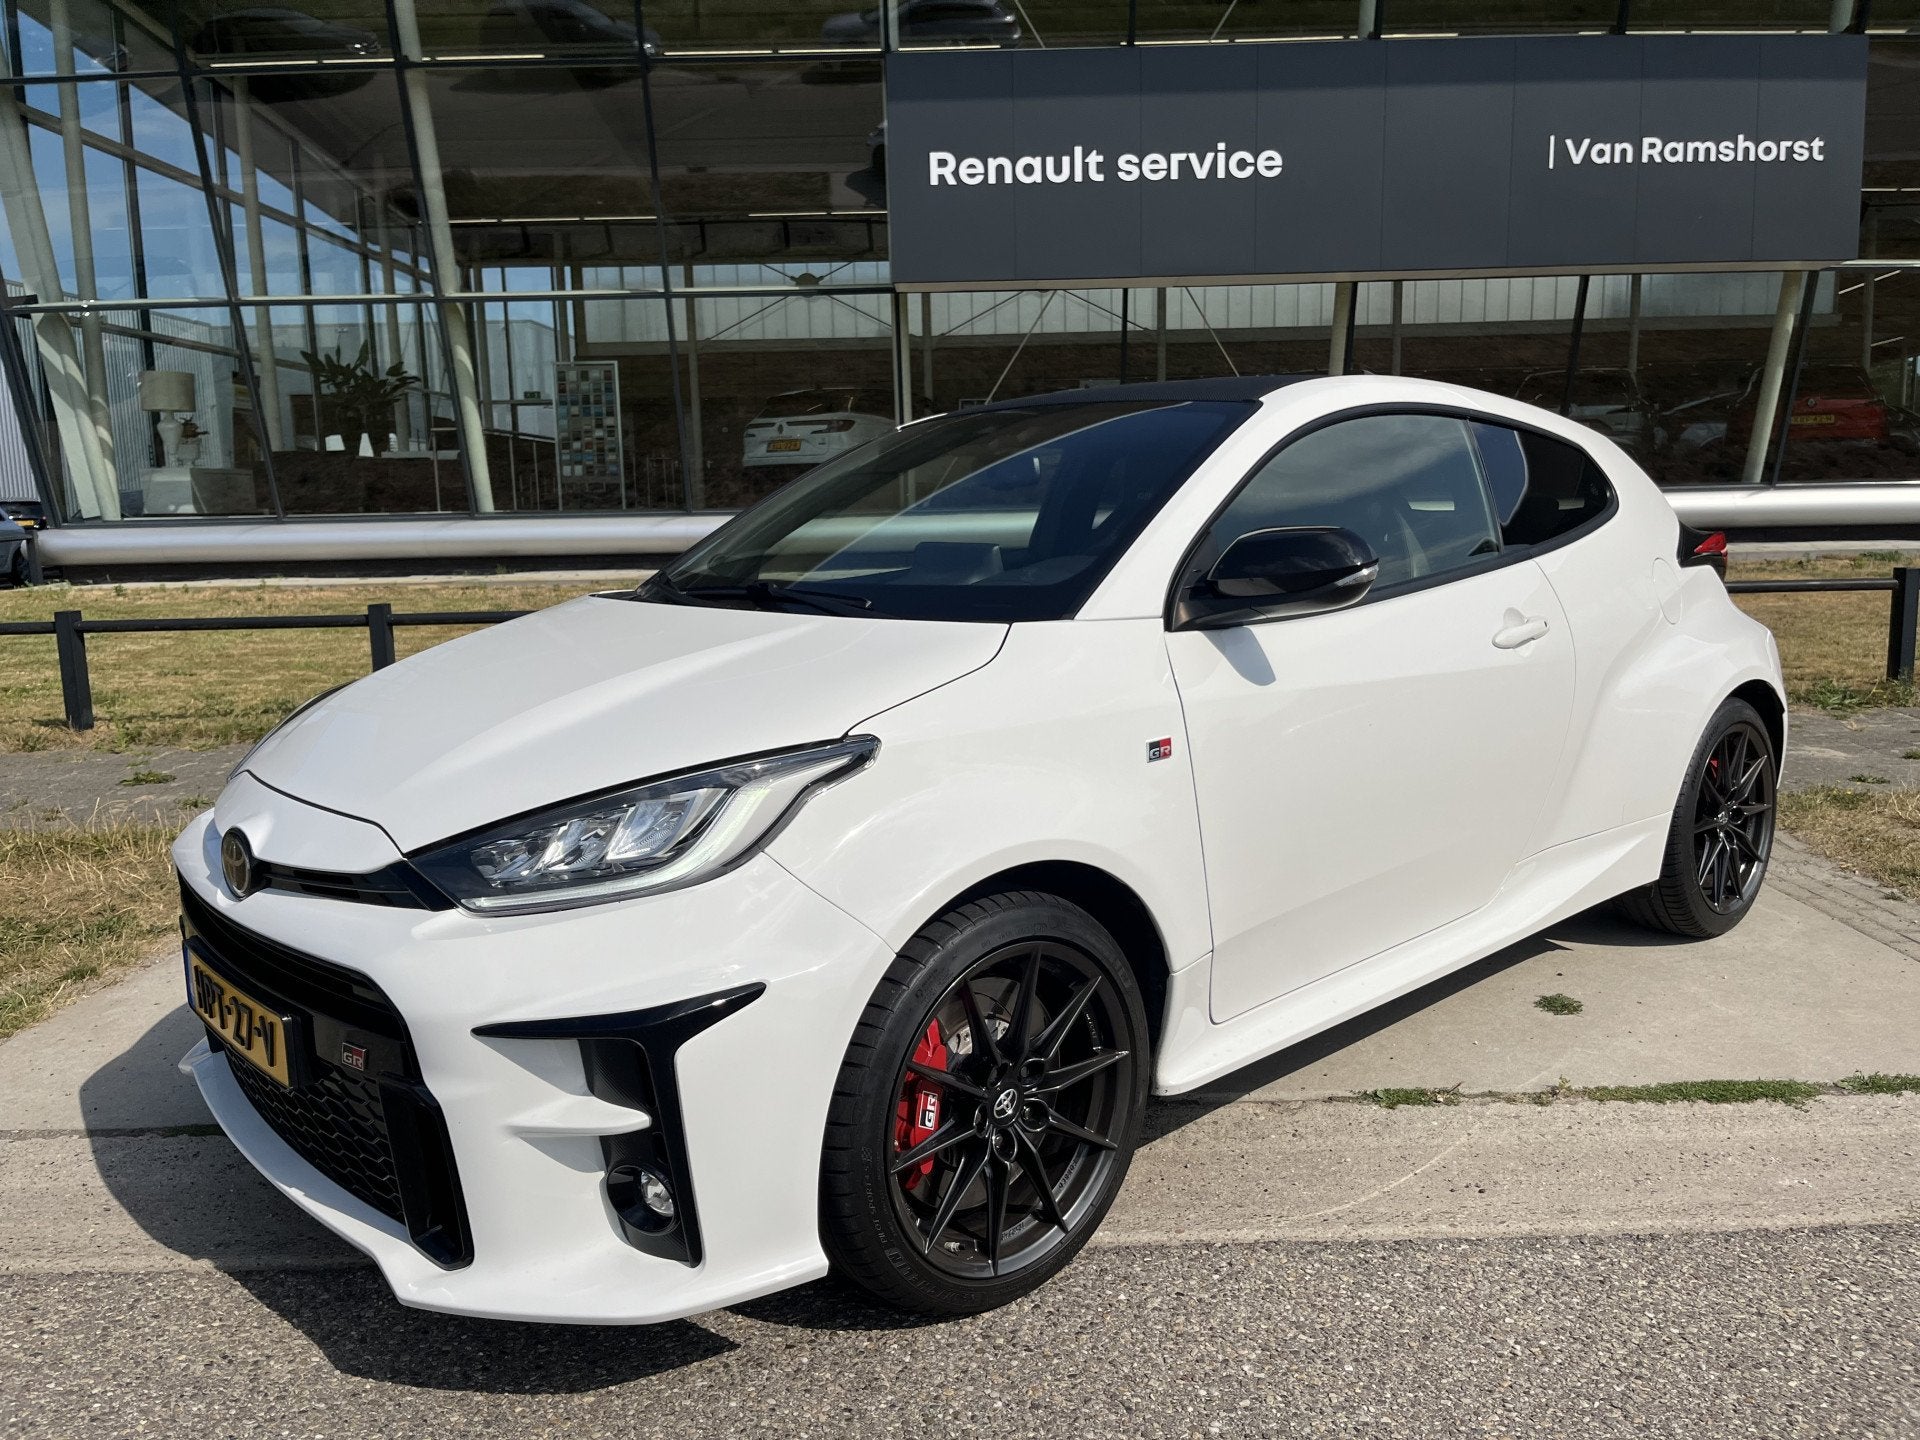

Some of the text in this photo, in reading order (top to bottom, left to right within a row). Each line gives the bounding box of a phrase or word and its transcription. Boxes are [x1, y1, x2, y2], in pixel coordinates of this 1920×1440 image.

[928, 142, 1284, 187] Renault service
[1564, 133, 1825, 165] Van Ramshorst
[924, 1094, 938, 1128] GR
